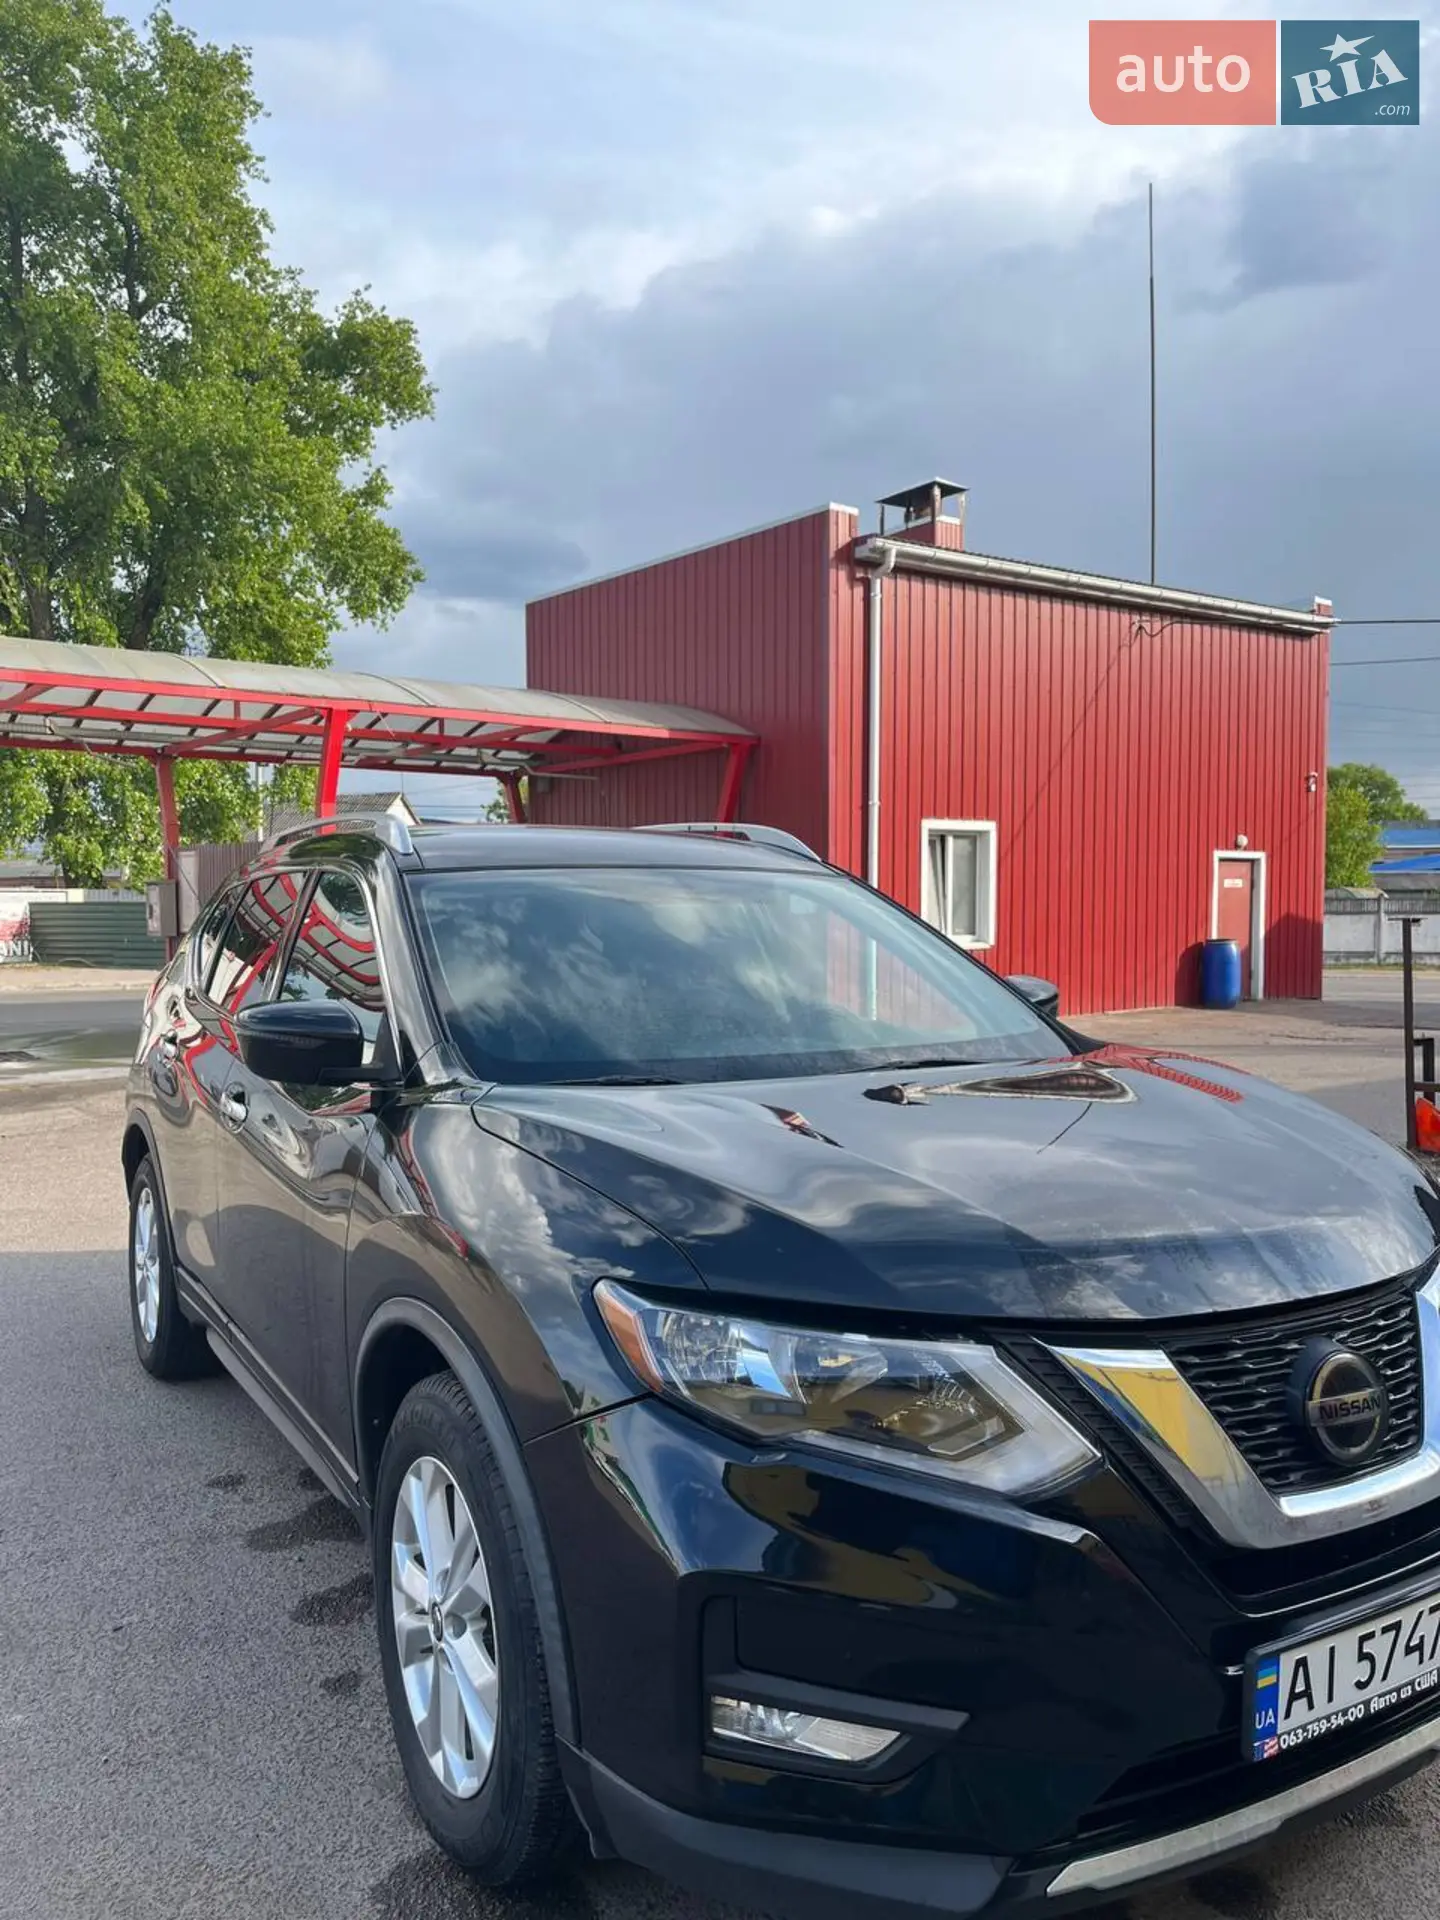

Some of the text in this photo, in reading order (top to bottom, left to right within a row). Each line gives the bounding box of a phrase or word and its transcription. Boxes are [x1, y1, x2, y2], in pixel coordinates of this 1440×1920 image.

[1319, 1395, 1380, 1419] NISSAN
[1283, 1603, 1440, 1720] AI 5747
[1255, 1711, 1276, 1729] UA
[1280, 1704, 1365, 1749] 063-759-54-00
[1370, 1692, 1398, 1713] Авто
[1415, 1669, 1438, 1691] США
